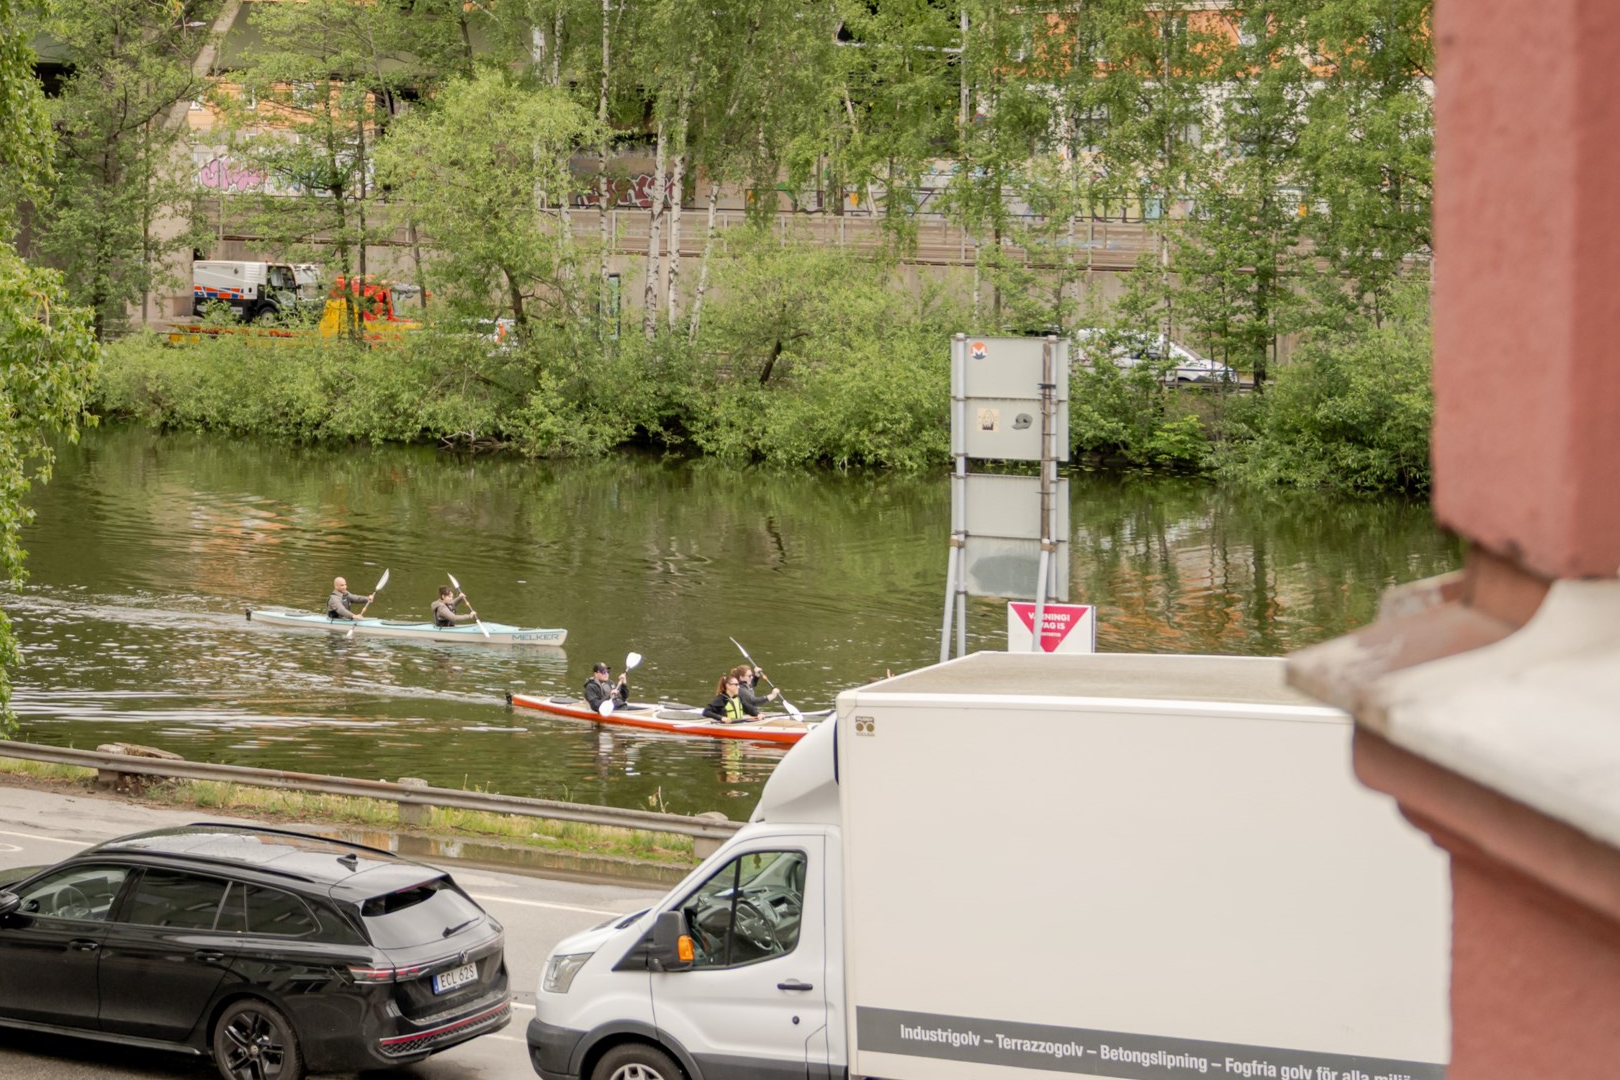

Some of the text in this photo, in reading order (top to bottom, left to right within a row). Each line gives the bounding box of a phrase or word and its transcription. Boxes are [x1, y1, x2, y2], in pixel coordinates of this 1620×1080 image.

[440, 972, 457, 988] ECL
[900, 1024, 980, 1047] Industrigolv
[996, 1033, 1083, 1058] Terrazzogolv
[1100, 1044, 1207, 1073] Betongslipning
[1225, 1057, 1277, 1078] Fogfria
[1280, 1064, 1313, 1080] golv
[1316, 1066, 1338, 1080] för
